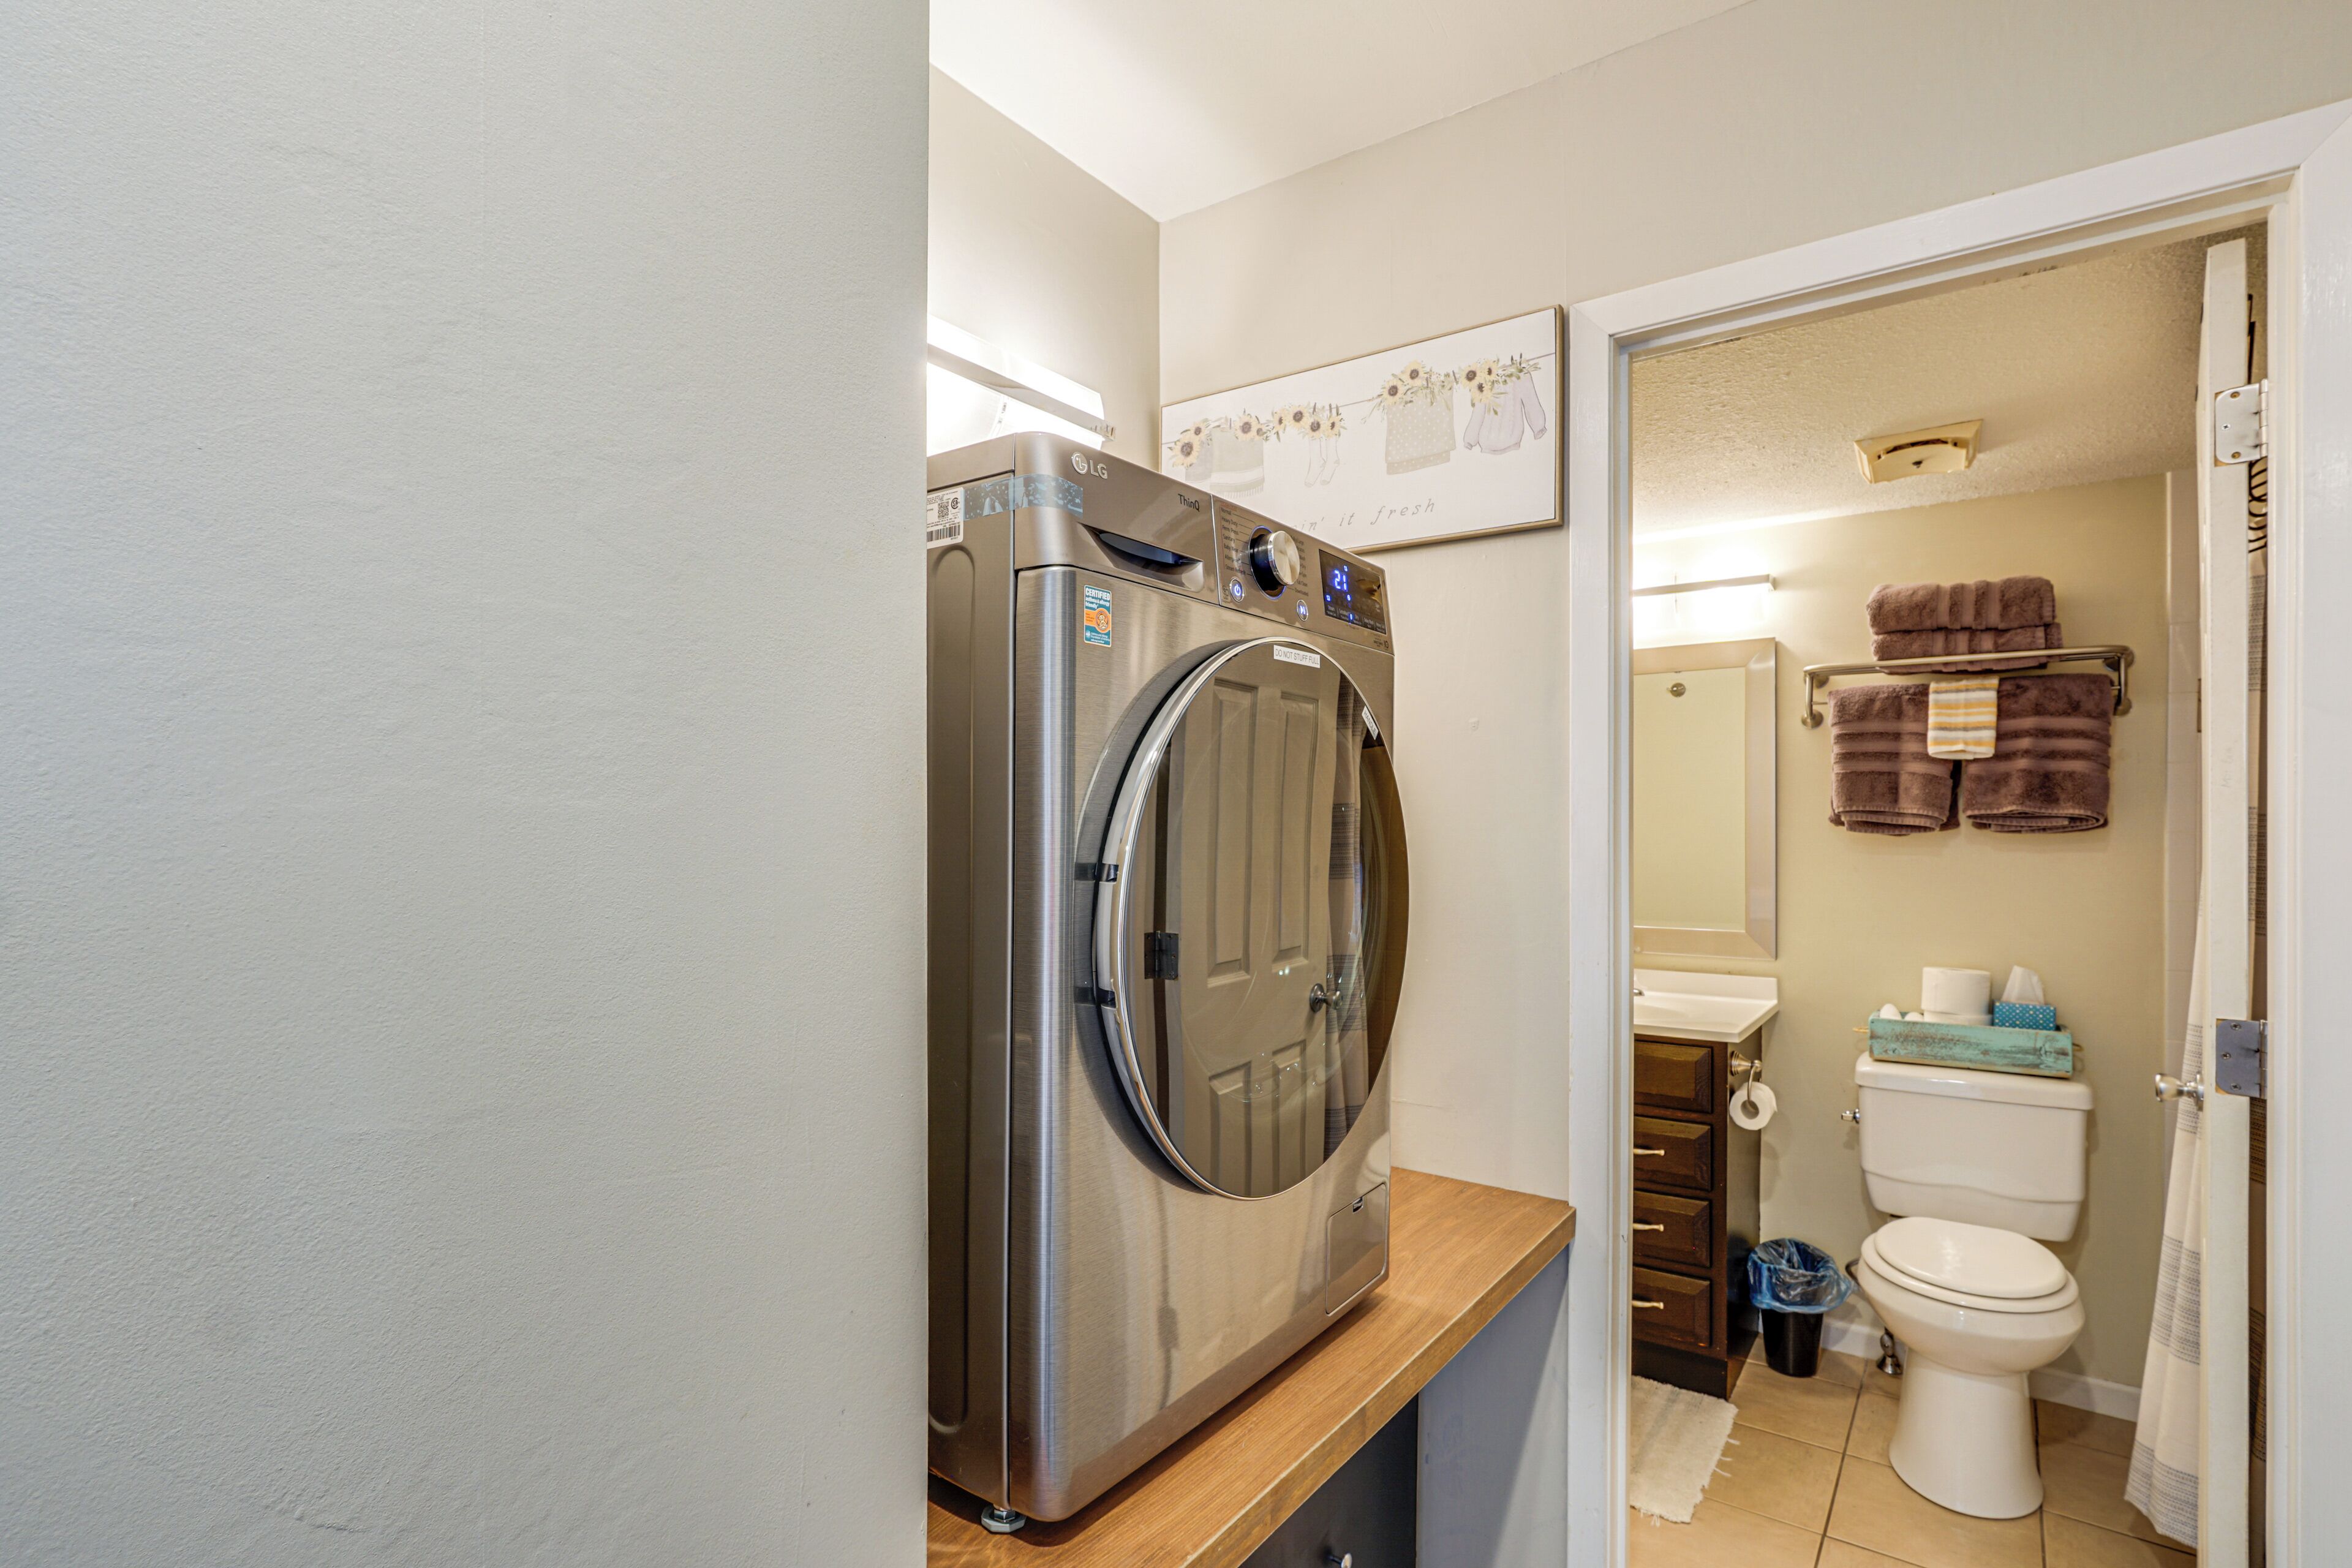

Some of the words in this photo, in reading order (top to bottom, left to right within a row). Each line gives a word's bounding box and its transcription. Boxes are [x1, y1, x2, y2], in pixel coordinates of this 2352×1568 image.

[1090, 459, 1108, 479] LG
[1178, 493, 1200, 512] ThinQ
[1293, 516, 1324, 532] in'
[1339, 513, 1355, 527] it
[1370, 499, 1435, 526] fresh
[1223, 533, 1235, 544] Sanitary
[1334, 570, 1346, 590] 21
[1085, 588, 1110, 601] CERTIFIED
[1085, 601, 1098, 609] friendly
[1275, 649, 1283, 657] DO
[1294, 653, 1308, 662] STUFF
[1308, 656, 1319, 665] FULL
[1364, 710, 1377, 735] HANDLE
